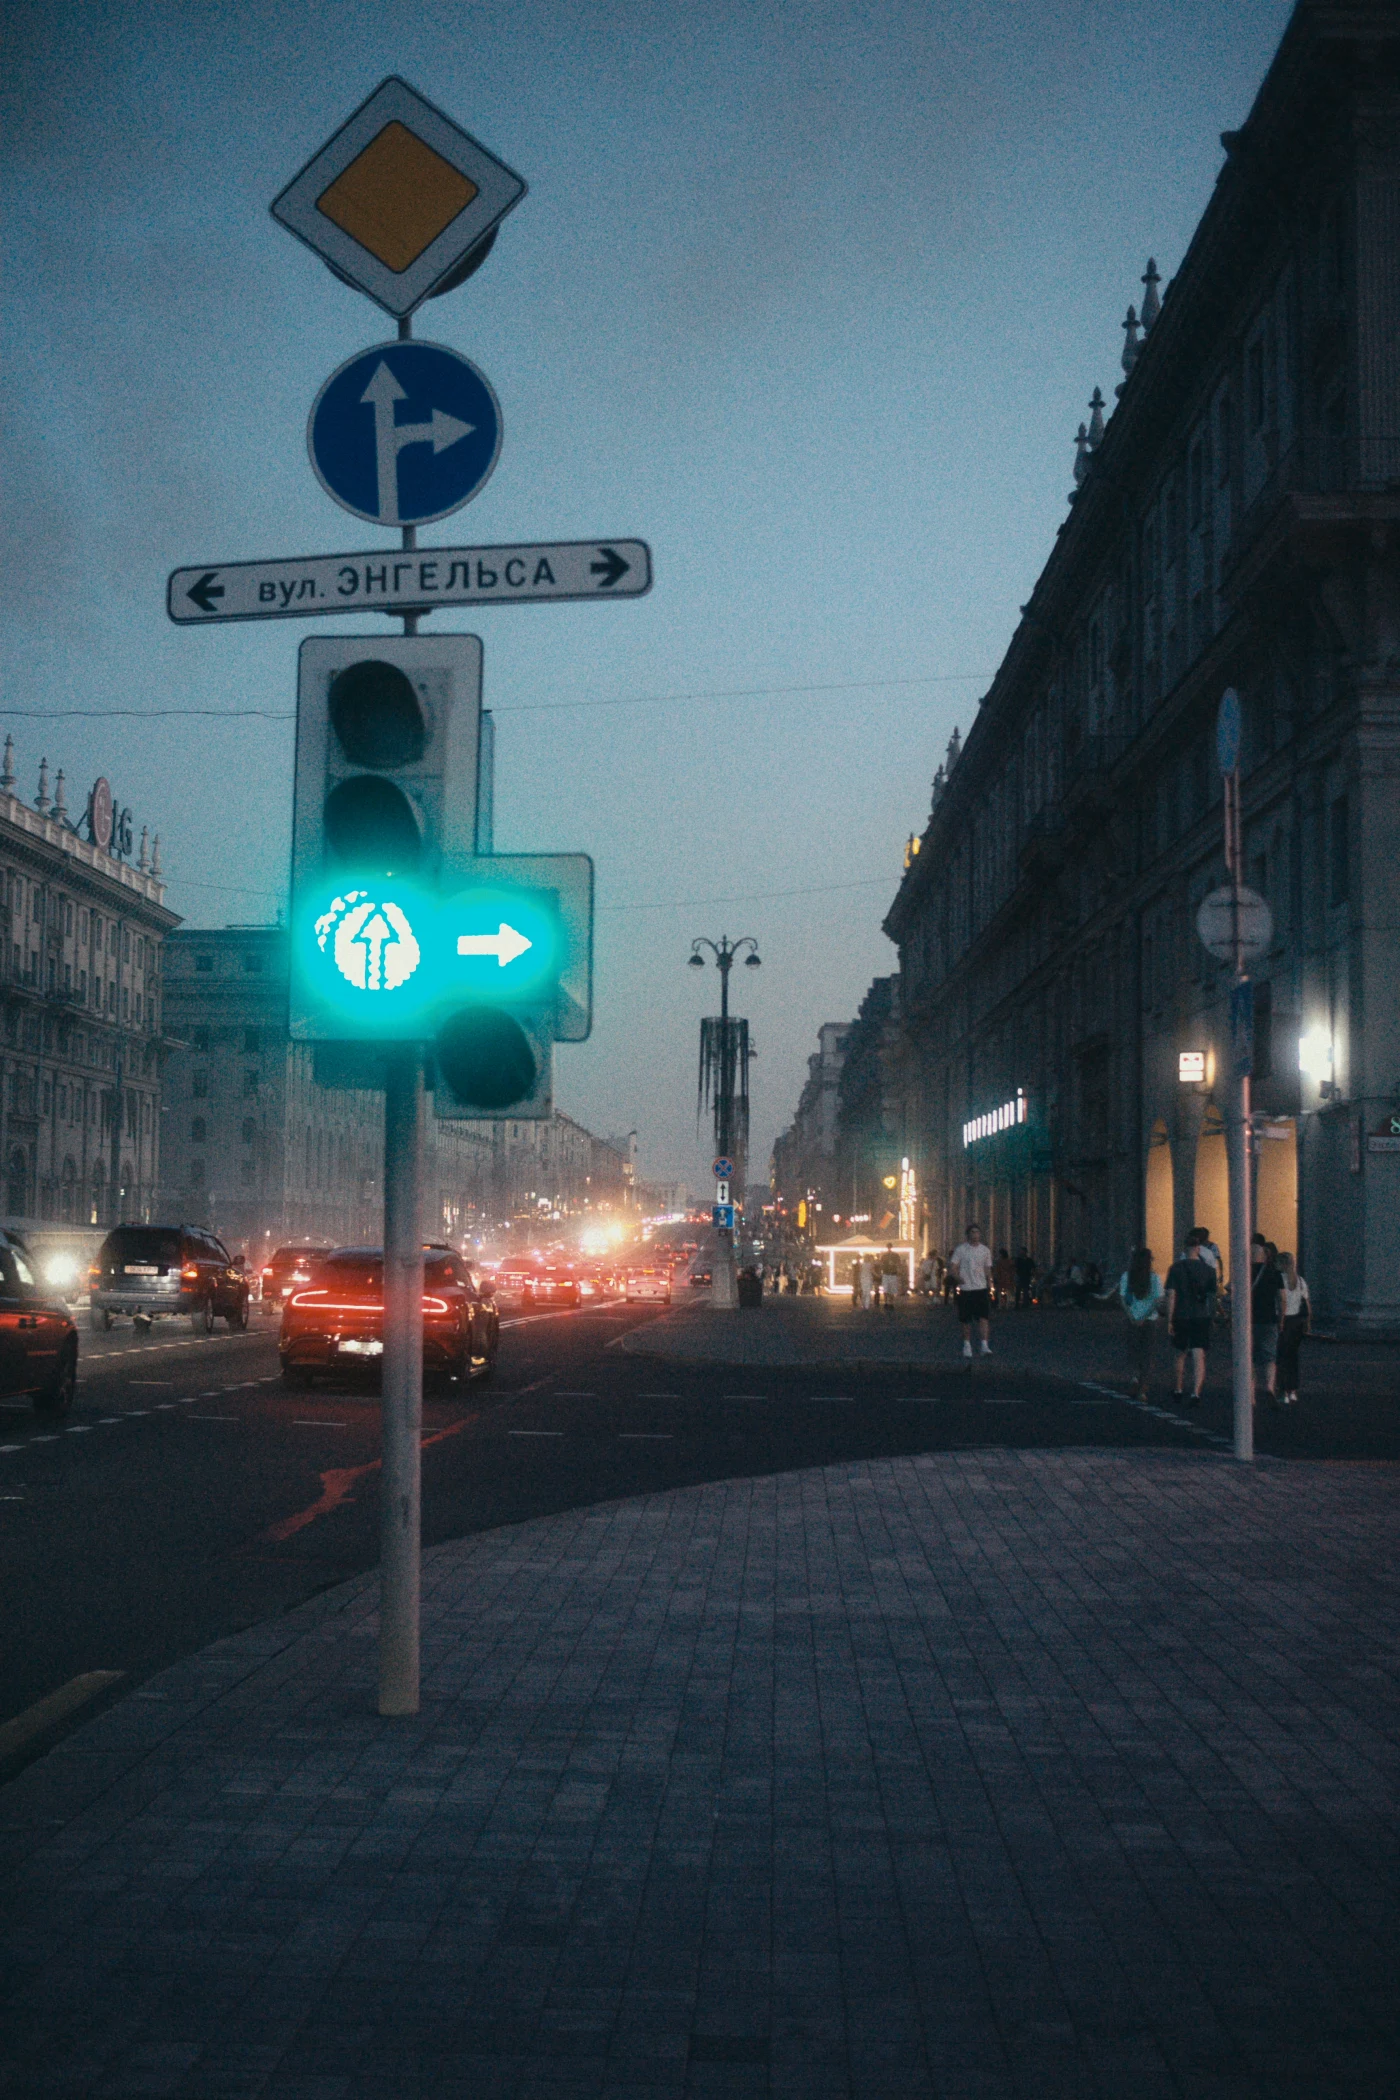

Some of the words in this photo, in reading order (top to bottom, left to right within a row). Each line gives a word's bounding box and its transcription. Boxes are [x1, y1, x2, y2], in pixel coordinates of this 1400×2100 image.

[259, 579, 325, 607] вул.
[337, 558, 556, 596] ЭНГЕЛЬСА
[112, 800, 133, 855] LG
